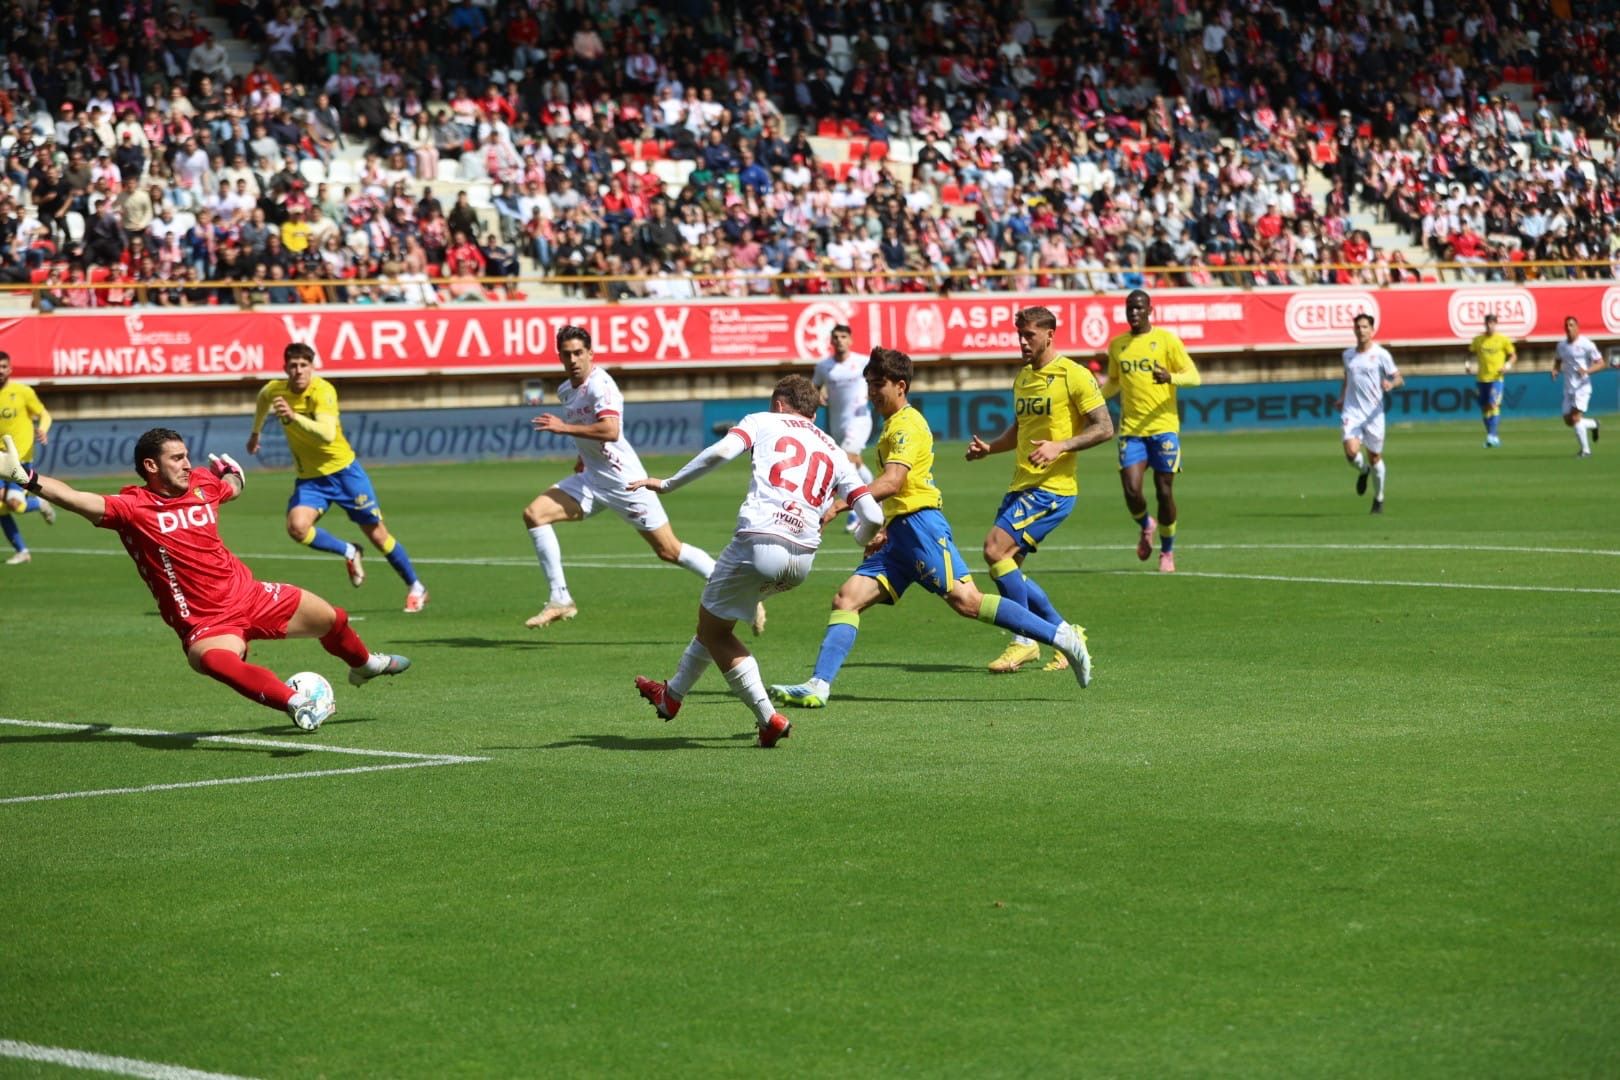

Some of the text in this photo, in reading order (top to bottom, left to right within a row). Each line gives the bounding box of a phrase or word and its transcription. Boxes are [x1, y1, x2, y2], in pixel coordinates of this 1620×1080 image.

[947, 303, 1063, 329] ASPIE
[502, 316, 650, 356] HOTLES
[962, 331, 1020, 348] ACADE
[53, 346, 166, 375] INFANTAS
[198, 341, 264, 371] LEÓN
[1120, 358, 1157, 374] DIGI
[1015, 397, 1052, 416] DIGI
[1178, 387, 1481, 424] YPERTION
[768, 435, 834, 508] 20
[157, 503, 216, 534] DIGI
